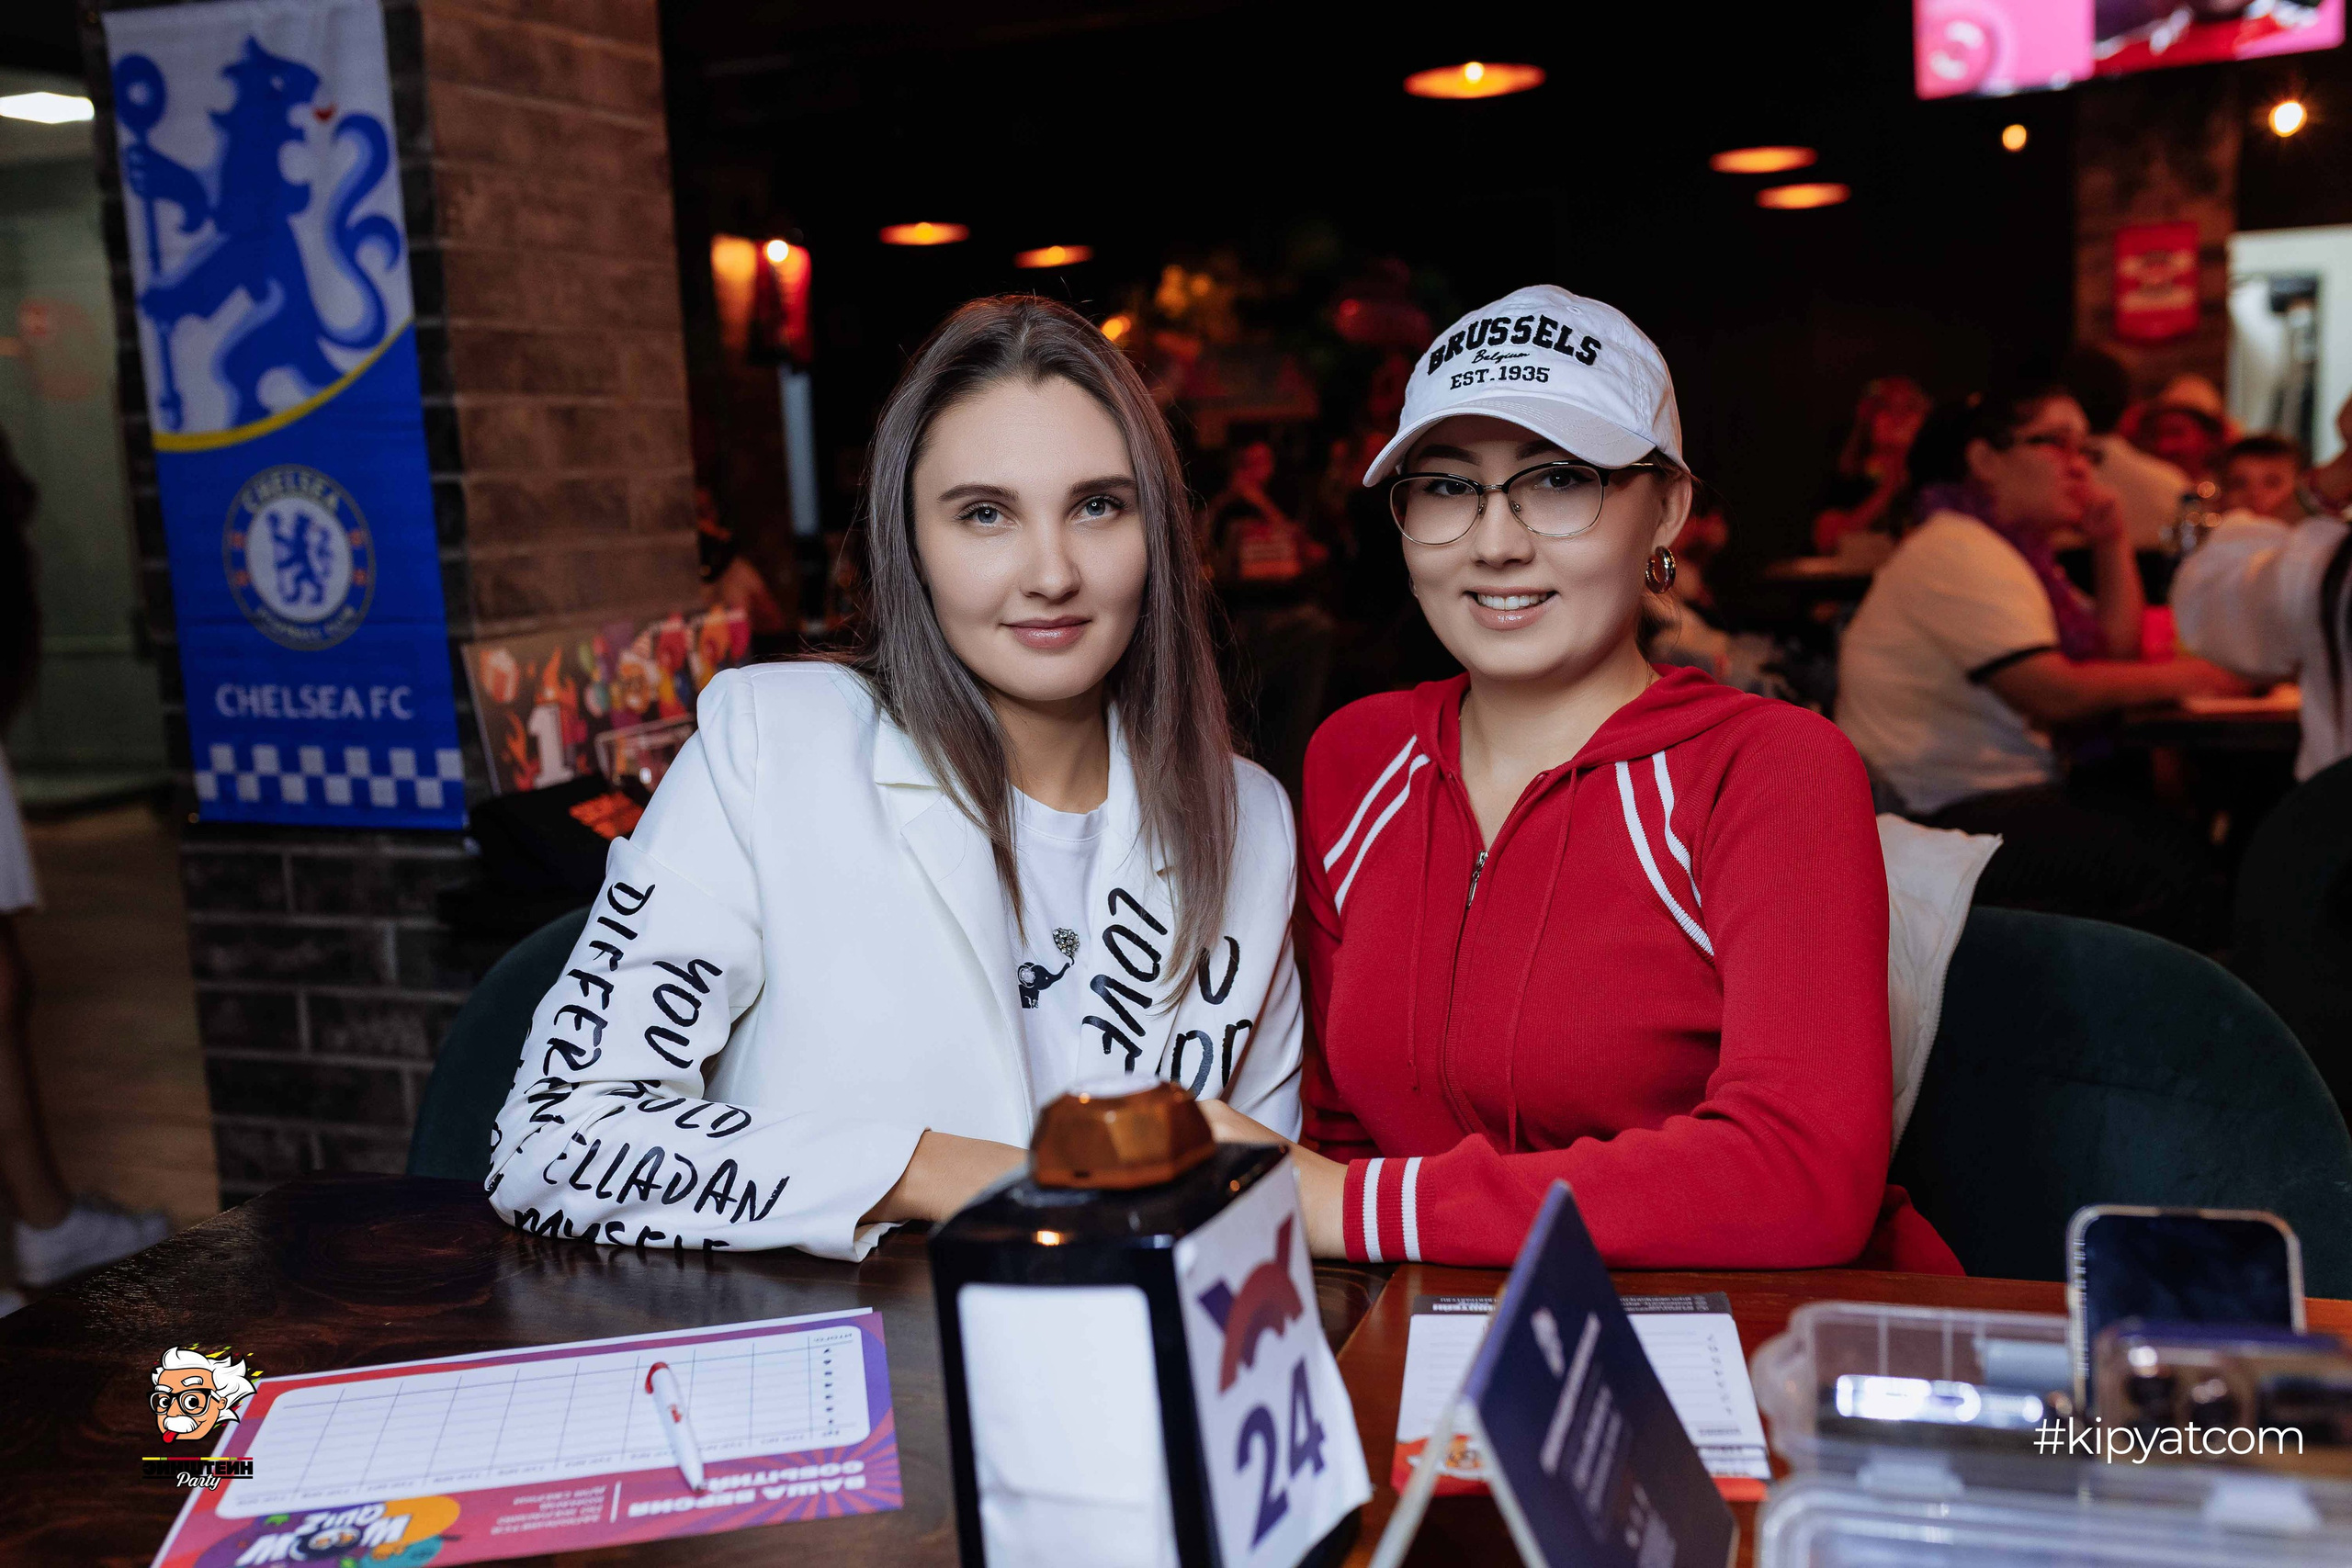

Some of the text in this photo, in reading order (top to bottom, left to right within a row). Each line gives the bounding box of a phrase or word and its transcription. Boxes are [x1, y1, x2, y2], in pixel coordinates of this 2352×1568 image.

[1427, 314, 1602, 376] BRUSSELS
[1472, 348, 1530, 364] Belgium
[216, 683, 413, 720] CHELSEA FC
[644, 958, 723, 1069] YOU
[1236, 1354, 1327, 1550] 24
